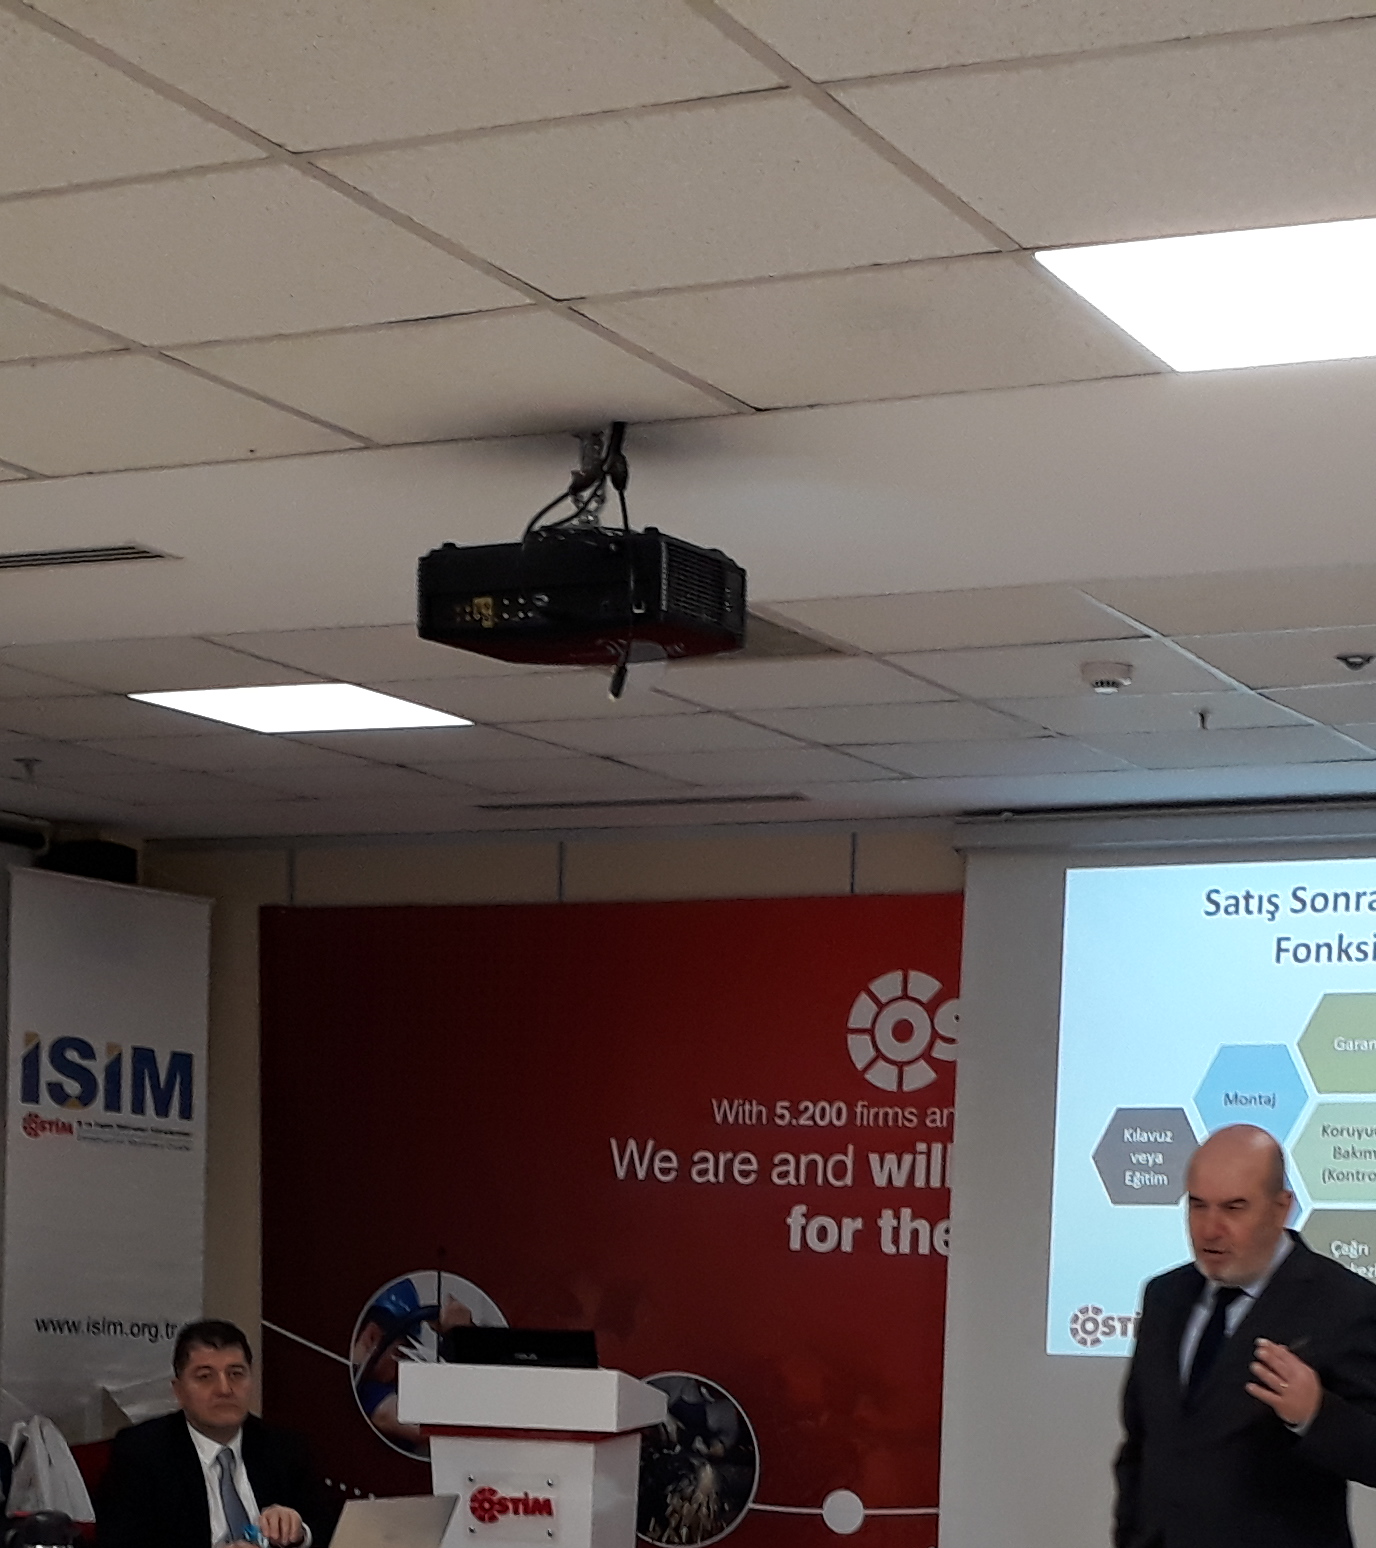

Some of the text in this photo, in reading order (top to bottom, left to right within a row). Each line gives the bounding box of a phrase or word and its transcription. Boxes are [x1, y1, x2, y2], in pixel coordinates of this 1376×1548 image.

[1204, 887, 1281, 920] Satış
[711, 1098, 766, 1127] With
[774, 1101, 847, 1128] 5.200
[855, 1101, 917, 1128] firms
[1224, 1092, 1276, 1109] Montaj
[1123, 1127, 1174, 1143] Kılavuz
[610, 1137, 678, 1183] We
[690, 1151, 758, 1185] are
[771, 1144, 854, 1187] and
[1129, 1153, 1164, 1167] veya
[1124, 1170, 1169, 1188] Eğitim
[787, 1205, 952, 1257] for the
[34, 1315, 178, 1344] www.isim.org.tr
